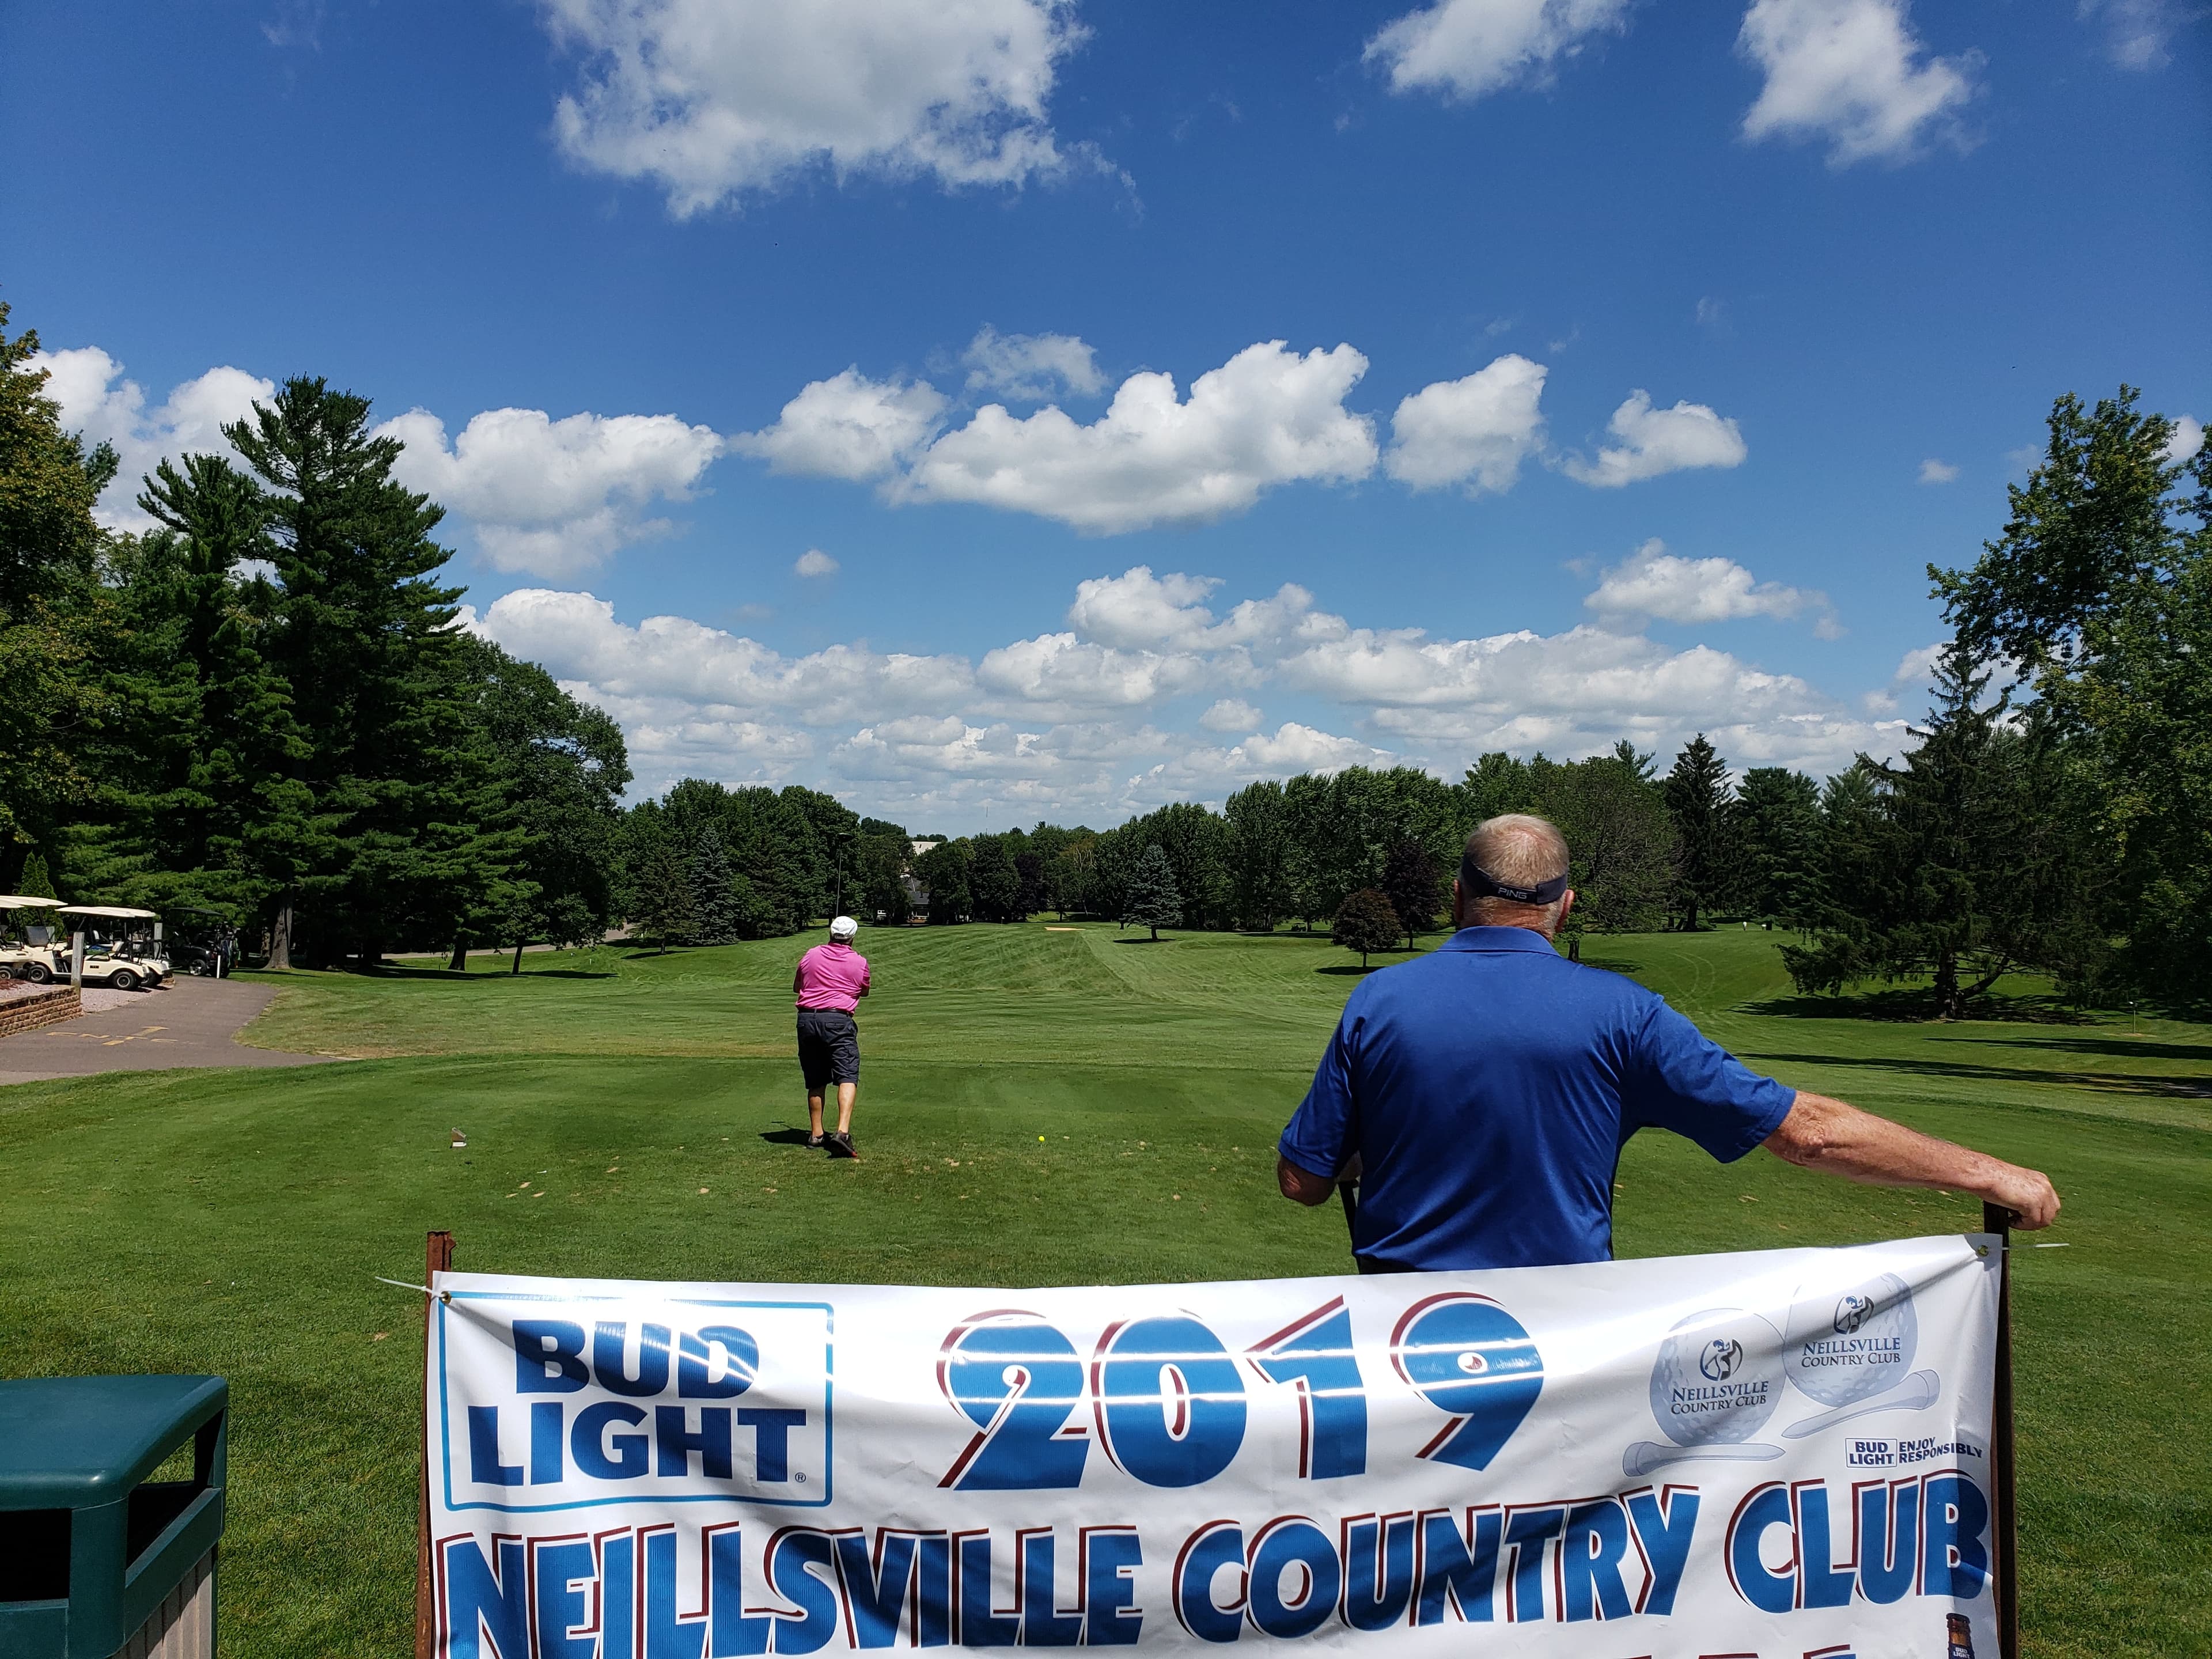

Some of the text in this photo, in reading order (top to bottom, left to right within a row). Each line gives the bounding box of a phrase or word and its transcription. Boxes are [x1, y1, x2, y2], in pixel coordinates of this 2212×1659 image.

[1498, 887, 1528, 899] PING
[1802, 1338, 1901, 1356] NEILLSVILLE
[512, 1320, 759, 1399] BUD
[1801, 1352, 1901, 1368] COUNTRY CLUB
[935, 1291, 1544, 1491] 2019
[1671, 1381, 1769, 1403] NEILLSVILLE
[1671, 1395, 1767, 1415] COUNTRY CLUB
[467, 1401, 806, 1486] LIGHT
[1855, 1441, 1888, 1453] BUD
[1899, 1437, 1936, 1453] ENJOY
[1899, 1442, 1983, 1464] RESPONSIBLY
[1849, 1453, 1895, 1465] LIGHT
[435, 1468, 1988, 1659] NEILLSVILLE COUNTRY CLUB
[1953, 1651, 1971, 1659] LIGHT
